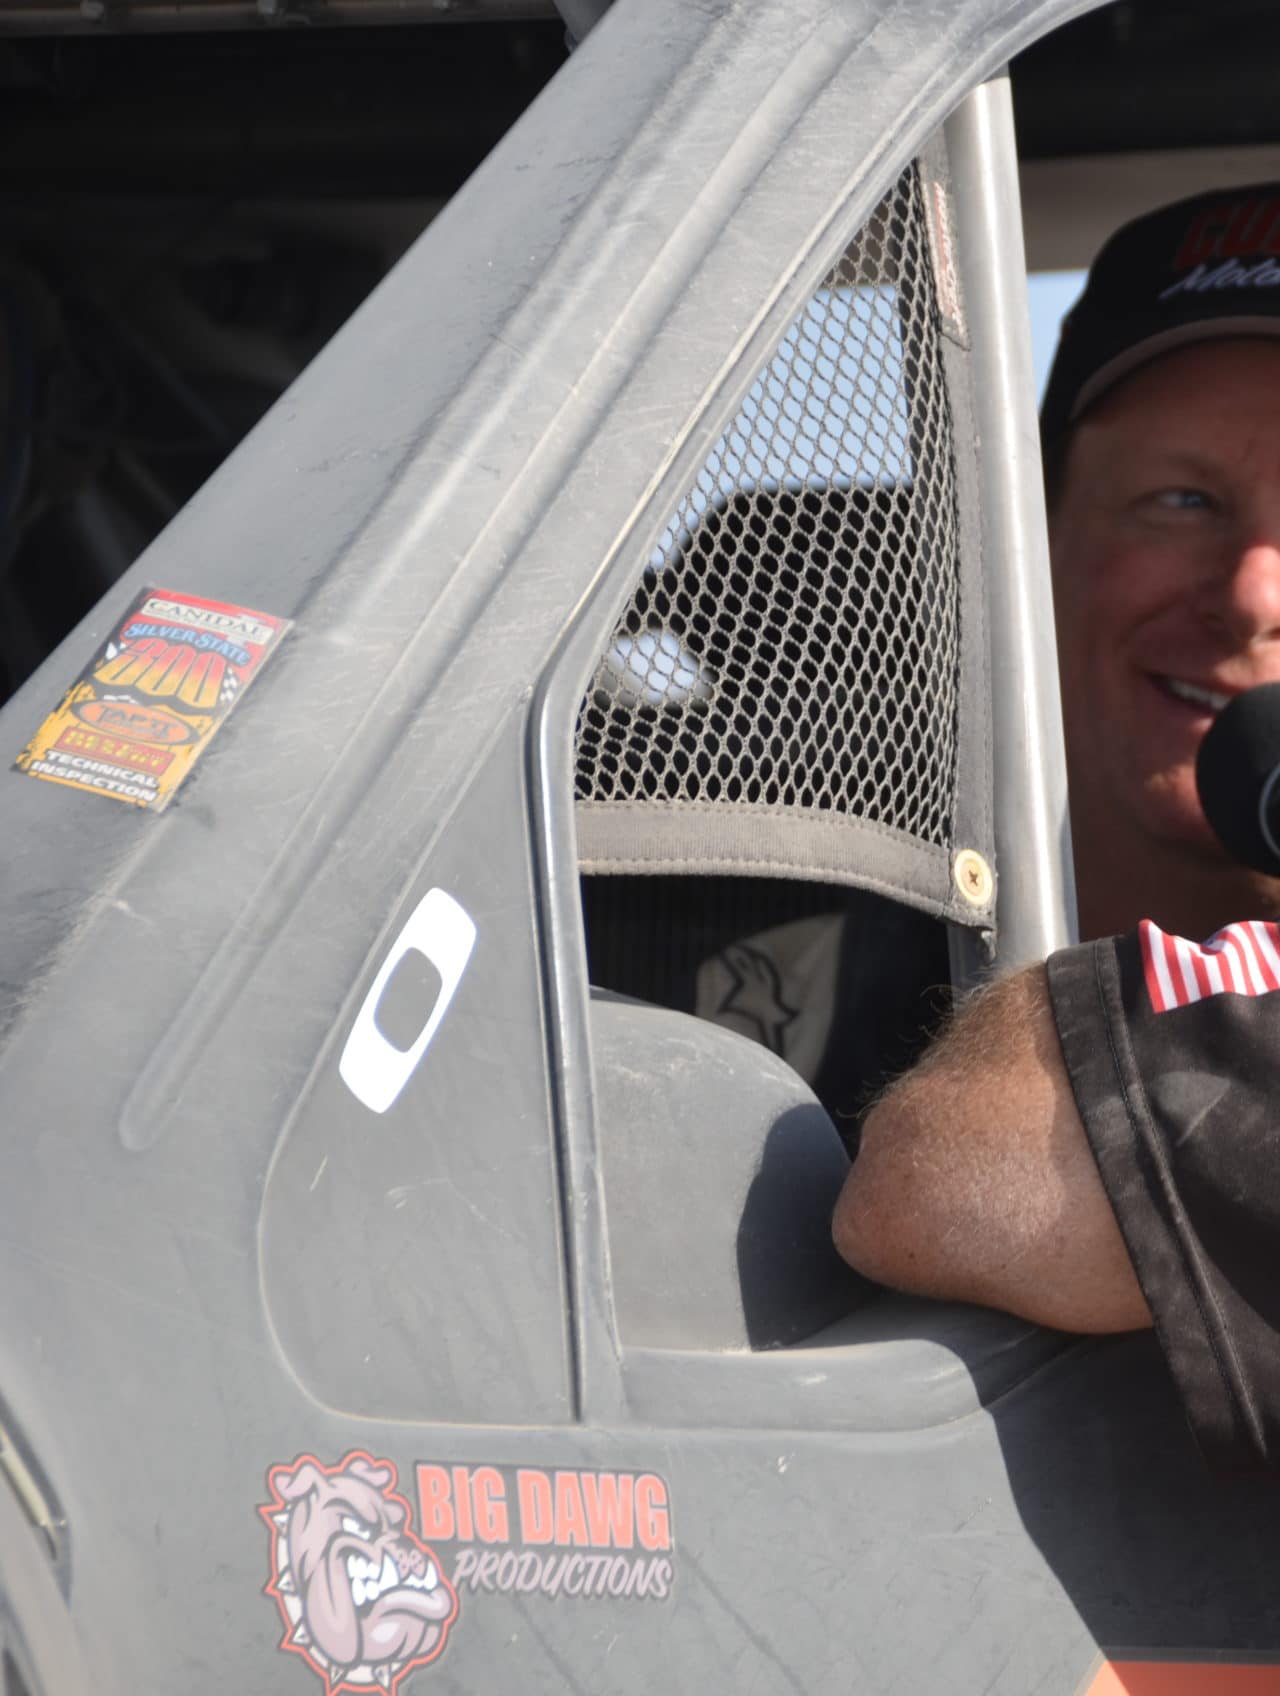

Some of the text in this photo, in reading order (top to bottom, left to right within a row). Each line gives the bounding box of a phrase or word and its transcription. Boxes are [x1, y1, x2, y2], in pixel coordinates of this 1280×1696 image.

[30, 761, 158, 801] INSPECTION
[46, 751, 160, 789] TECHNICAL
[415, 1463, 672, 1551] BIG DAWG
[453, 1549, 674, 1598] PRODUCTIONS
